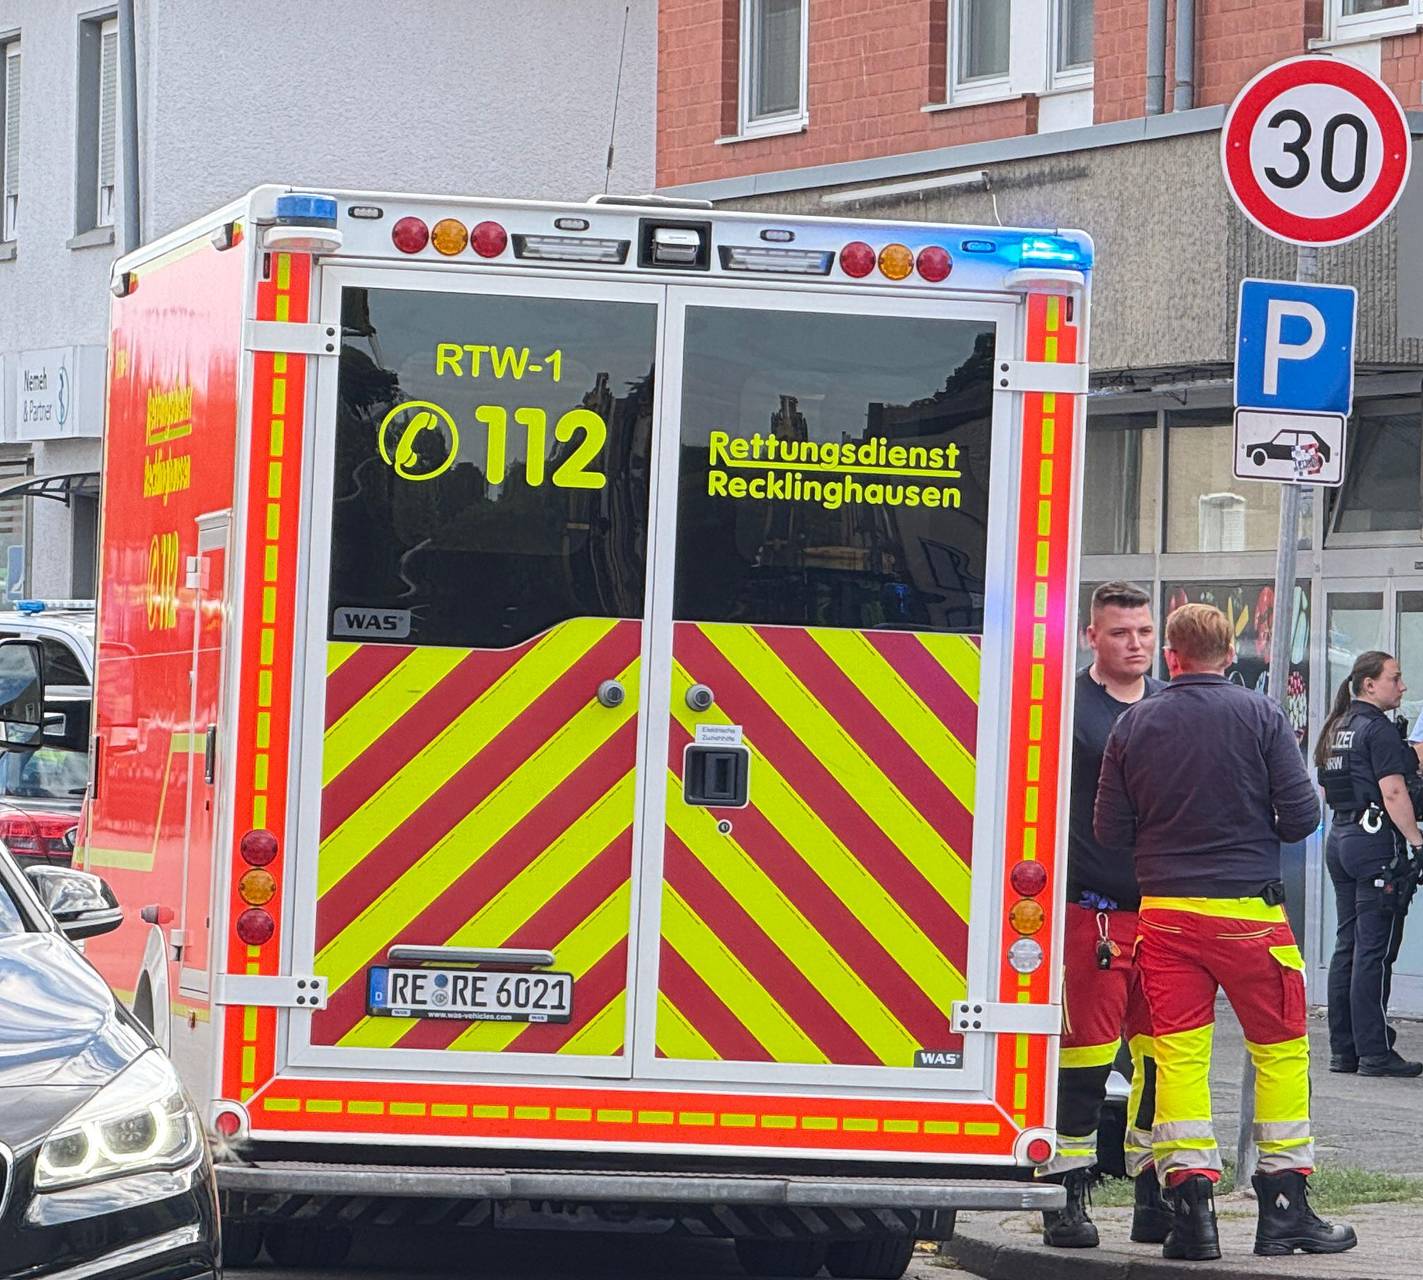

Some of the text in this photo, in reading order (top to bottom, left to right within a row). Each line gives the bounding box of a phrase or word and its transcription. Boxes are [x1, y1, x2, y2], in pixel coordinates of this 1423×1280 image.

[1264, 109, 1368, 193] 30
[436, 343, 562, 382] RTW-1
[1263, 299, 1326, 395] P
[475, 405, 607, 489] 112
[709, 431, 960, 471] Rettungsdienst
[708, 470, 961, 510] Recklinghausen
[344, 614, 398, 630] WAS
[376, 991, 383, 1000] D
[392, 973, 566, 1010] RE RE 6021
[920, 1052, 957, 1065] WAS
